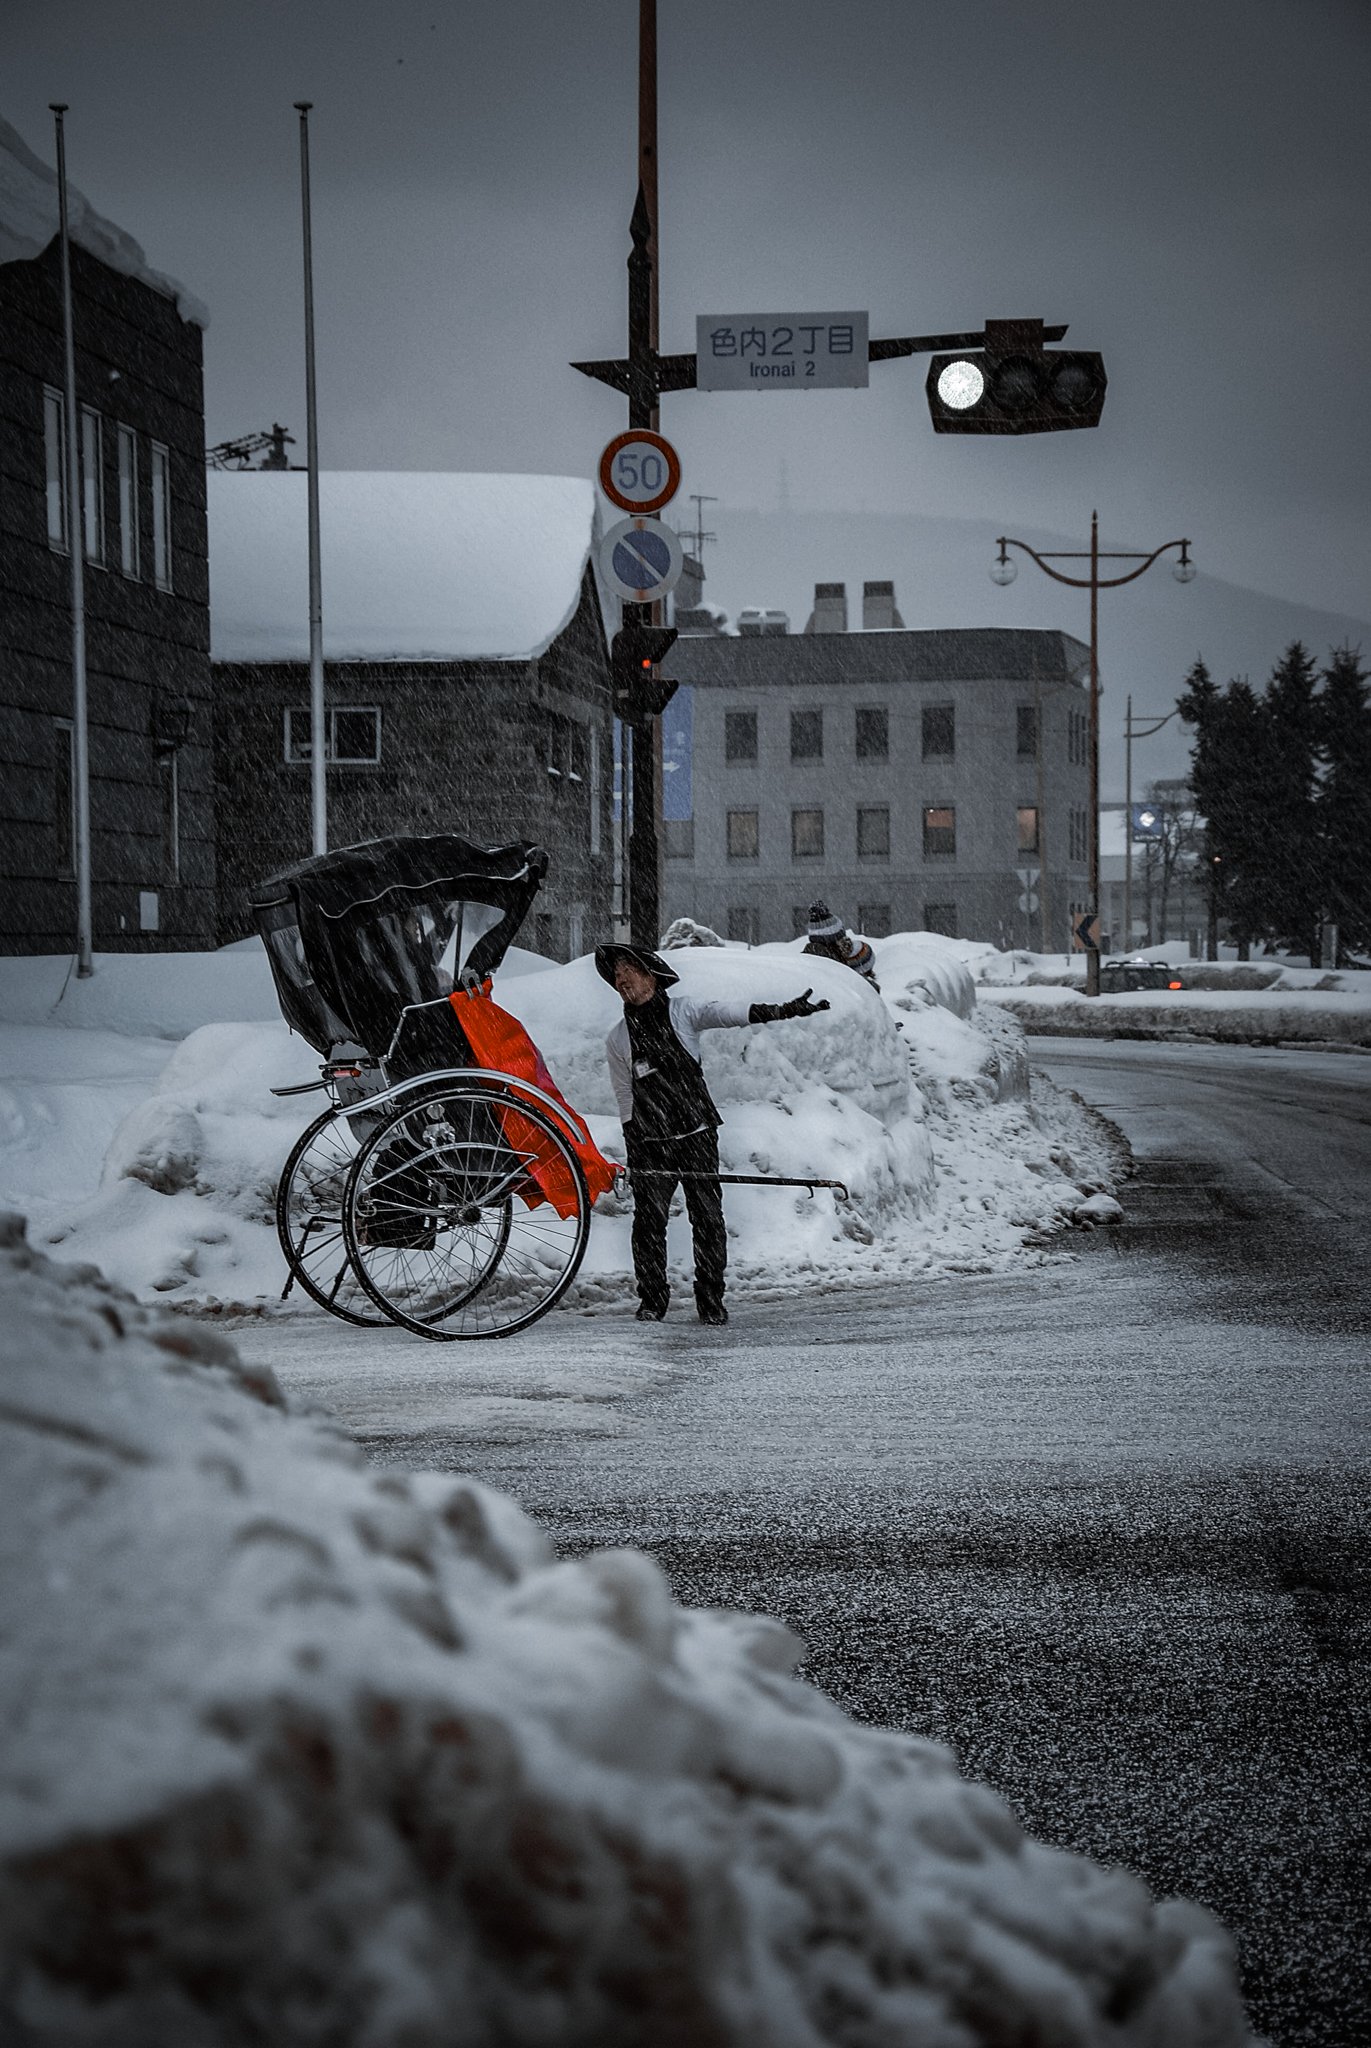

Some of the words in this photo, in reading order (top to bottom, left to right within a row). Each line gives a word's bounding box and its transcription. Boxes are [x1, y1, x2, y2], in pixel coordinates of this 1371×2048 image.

[710, 326, 853, 357] 色内2丁目
[750, 361, 795, 377] Ironai
[805, 361, 816, 376] 2
[618, 454, 662, 490] 50
